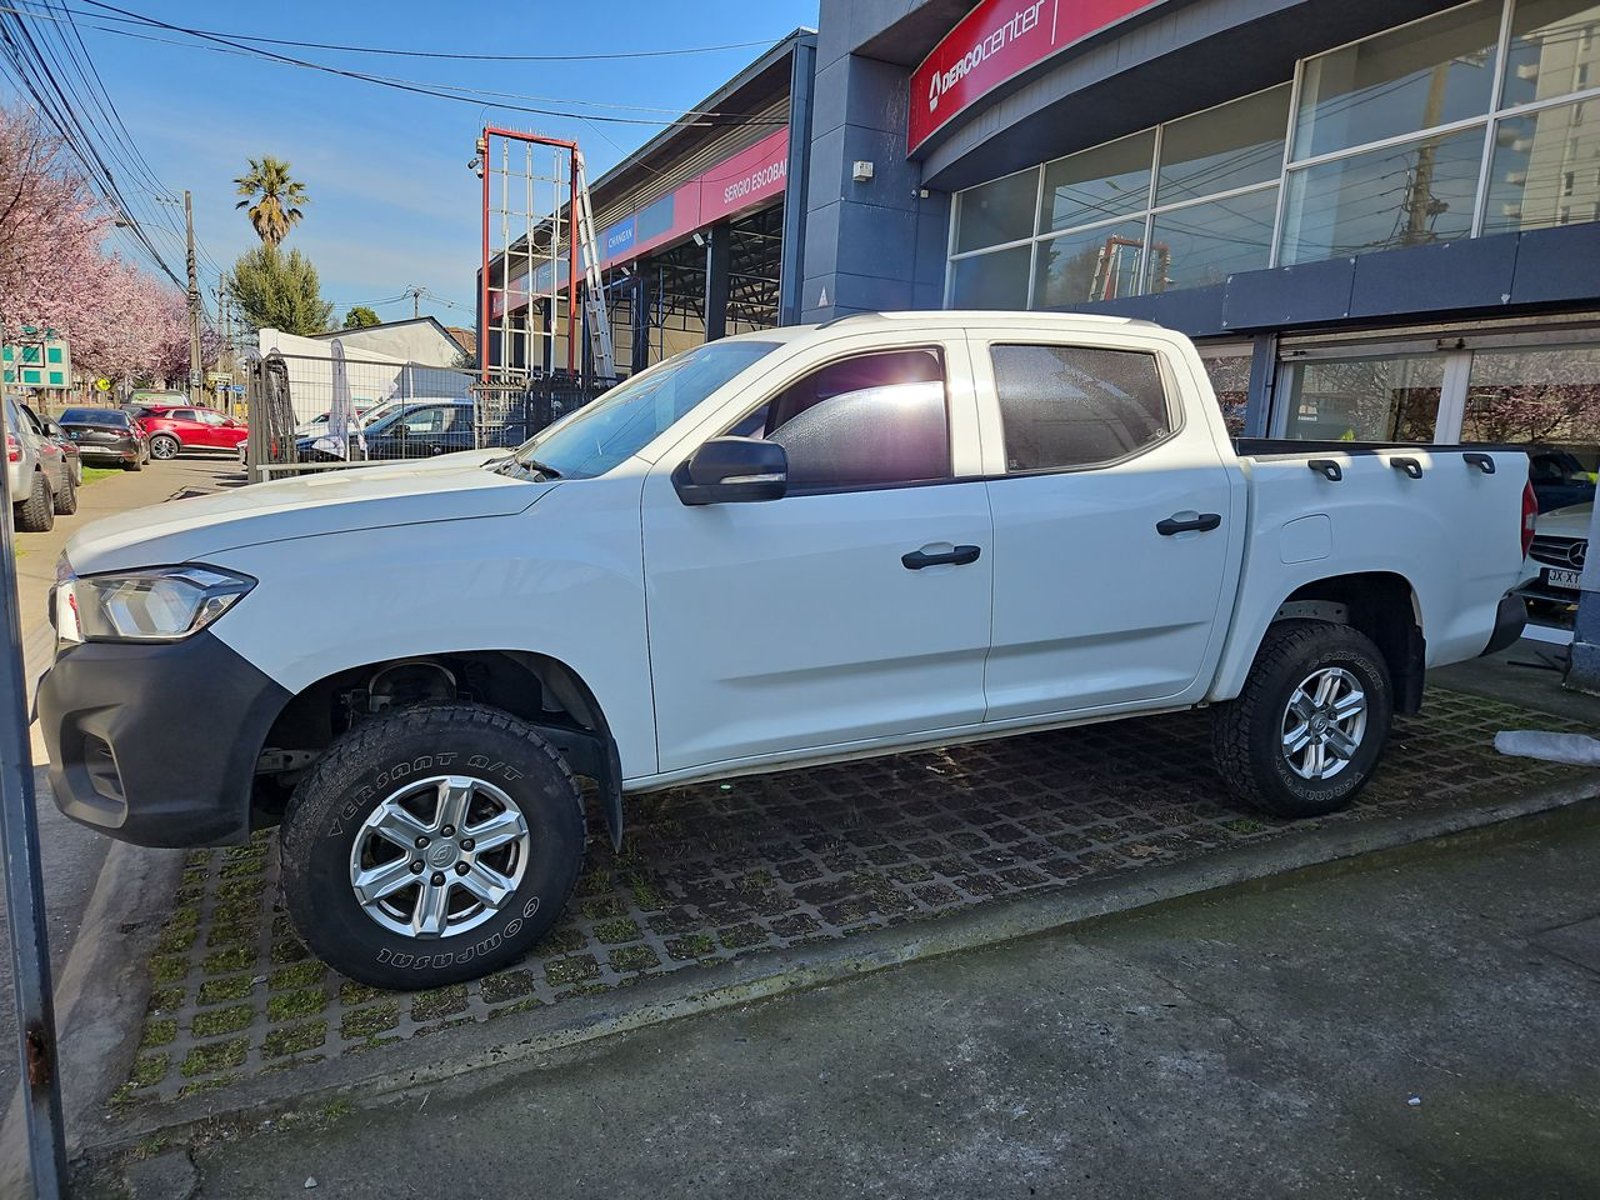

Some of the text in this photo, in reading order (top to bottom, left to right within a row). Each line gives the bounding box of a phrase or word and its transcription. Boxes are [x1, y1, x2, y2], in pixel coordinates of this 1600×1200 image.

[941, 0, 1045, 95] DERCOcenter
[723, 175, 751, 205] SERGIO
[327, 752, 525, 837] VERSANT A/T
[375, 895, 540, 970] COMPASAL
